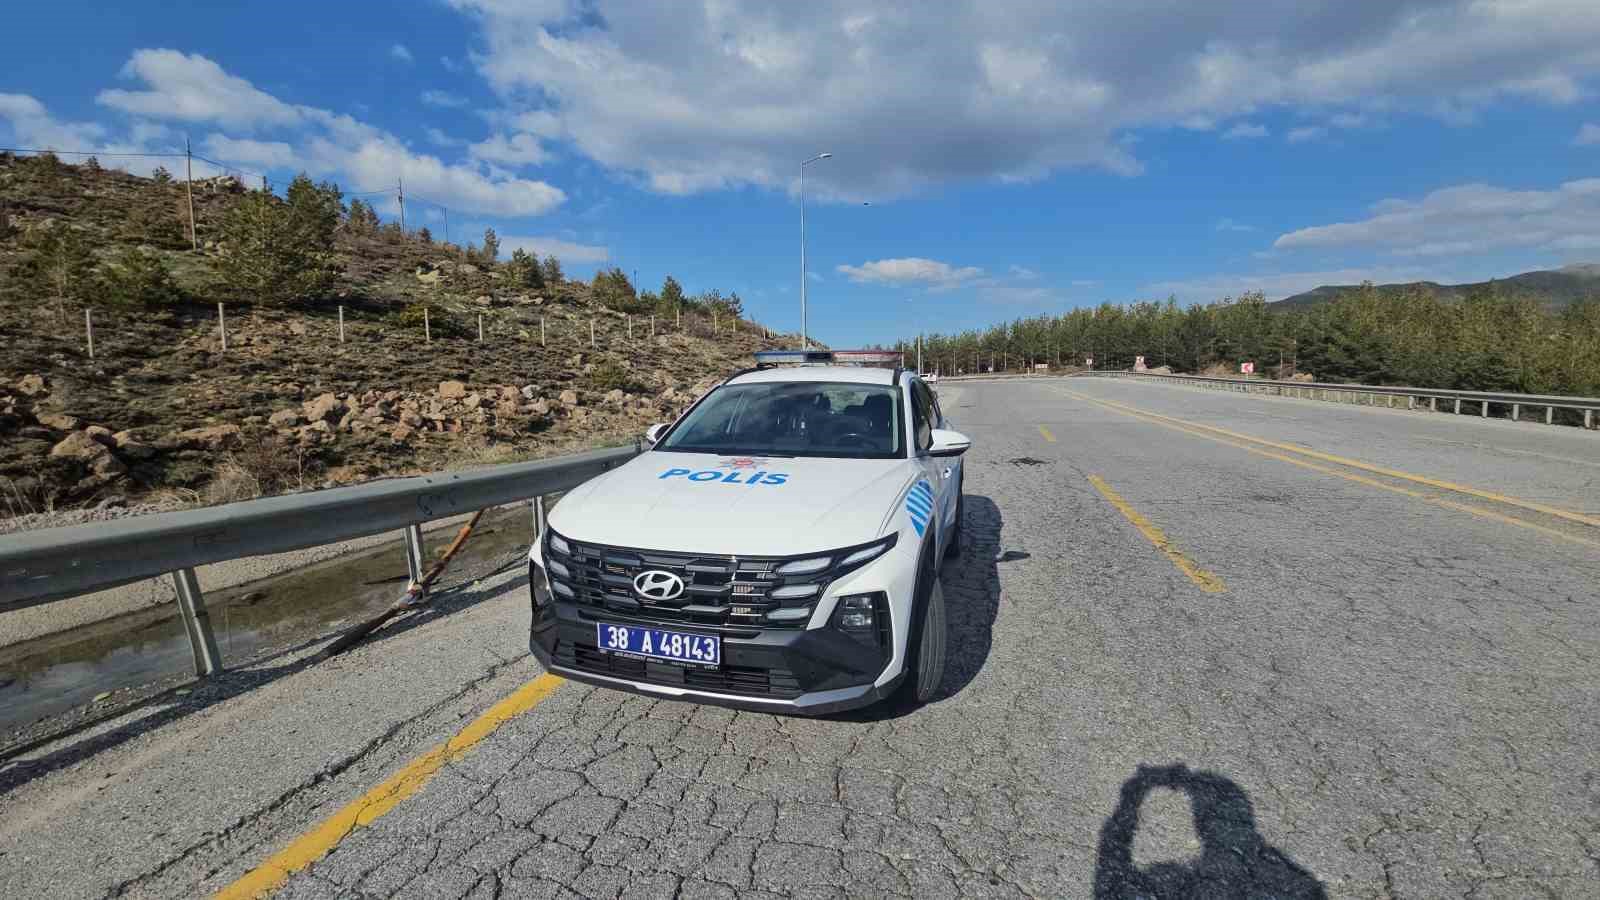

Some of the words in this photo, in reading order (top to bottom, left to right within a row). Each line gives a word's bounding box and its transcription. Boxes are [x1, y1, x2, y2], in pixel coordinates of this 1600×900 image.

[607, 626, 629, 650] 38
[642, 631, 653, 654] A
[660, 633, 715, 660] 48143
